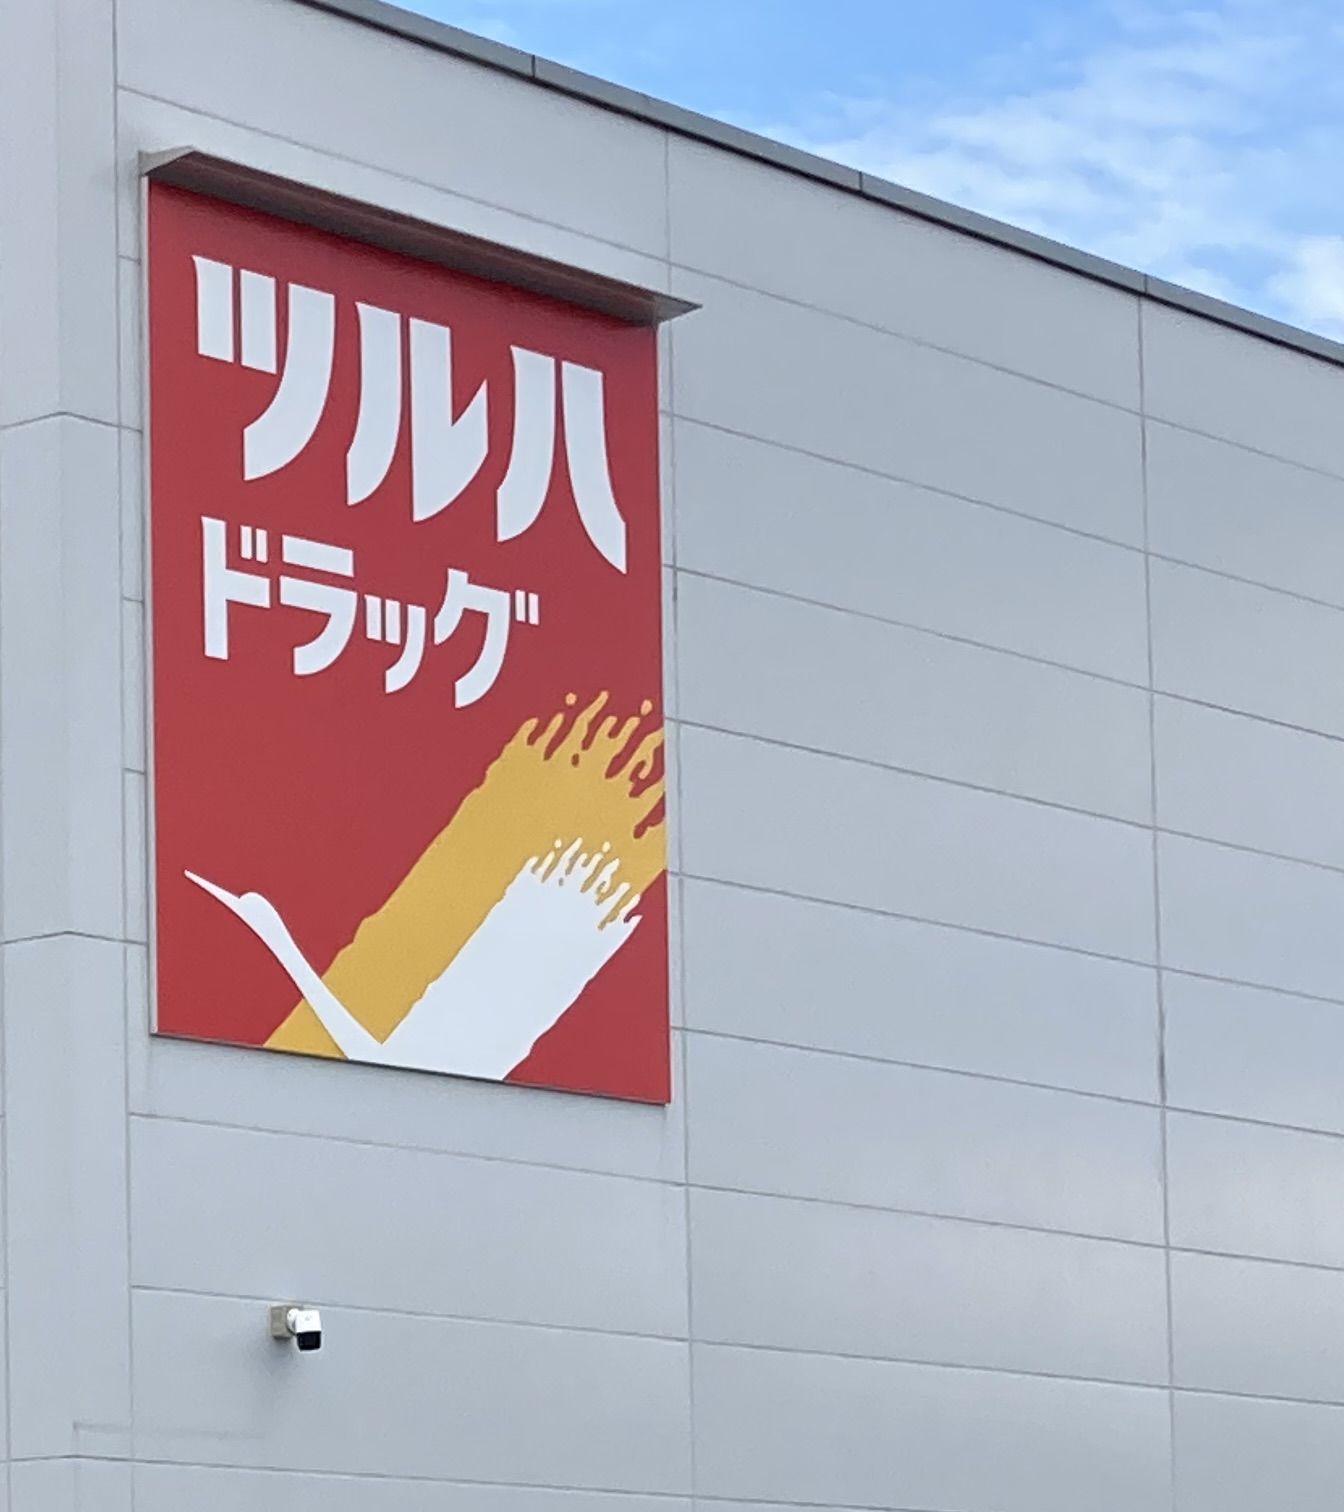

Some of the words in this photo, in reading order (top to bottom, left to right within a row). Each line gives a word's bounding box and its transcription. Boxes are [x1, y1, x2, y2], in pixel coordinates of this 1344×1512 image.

[192, 254, 626, 574] ツルハ
[201, 515, 539, 709] ドラッグ
